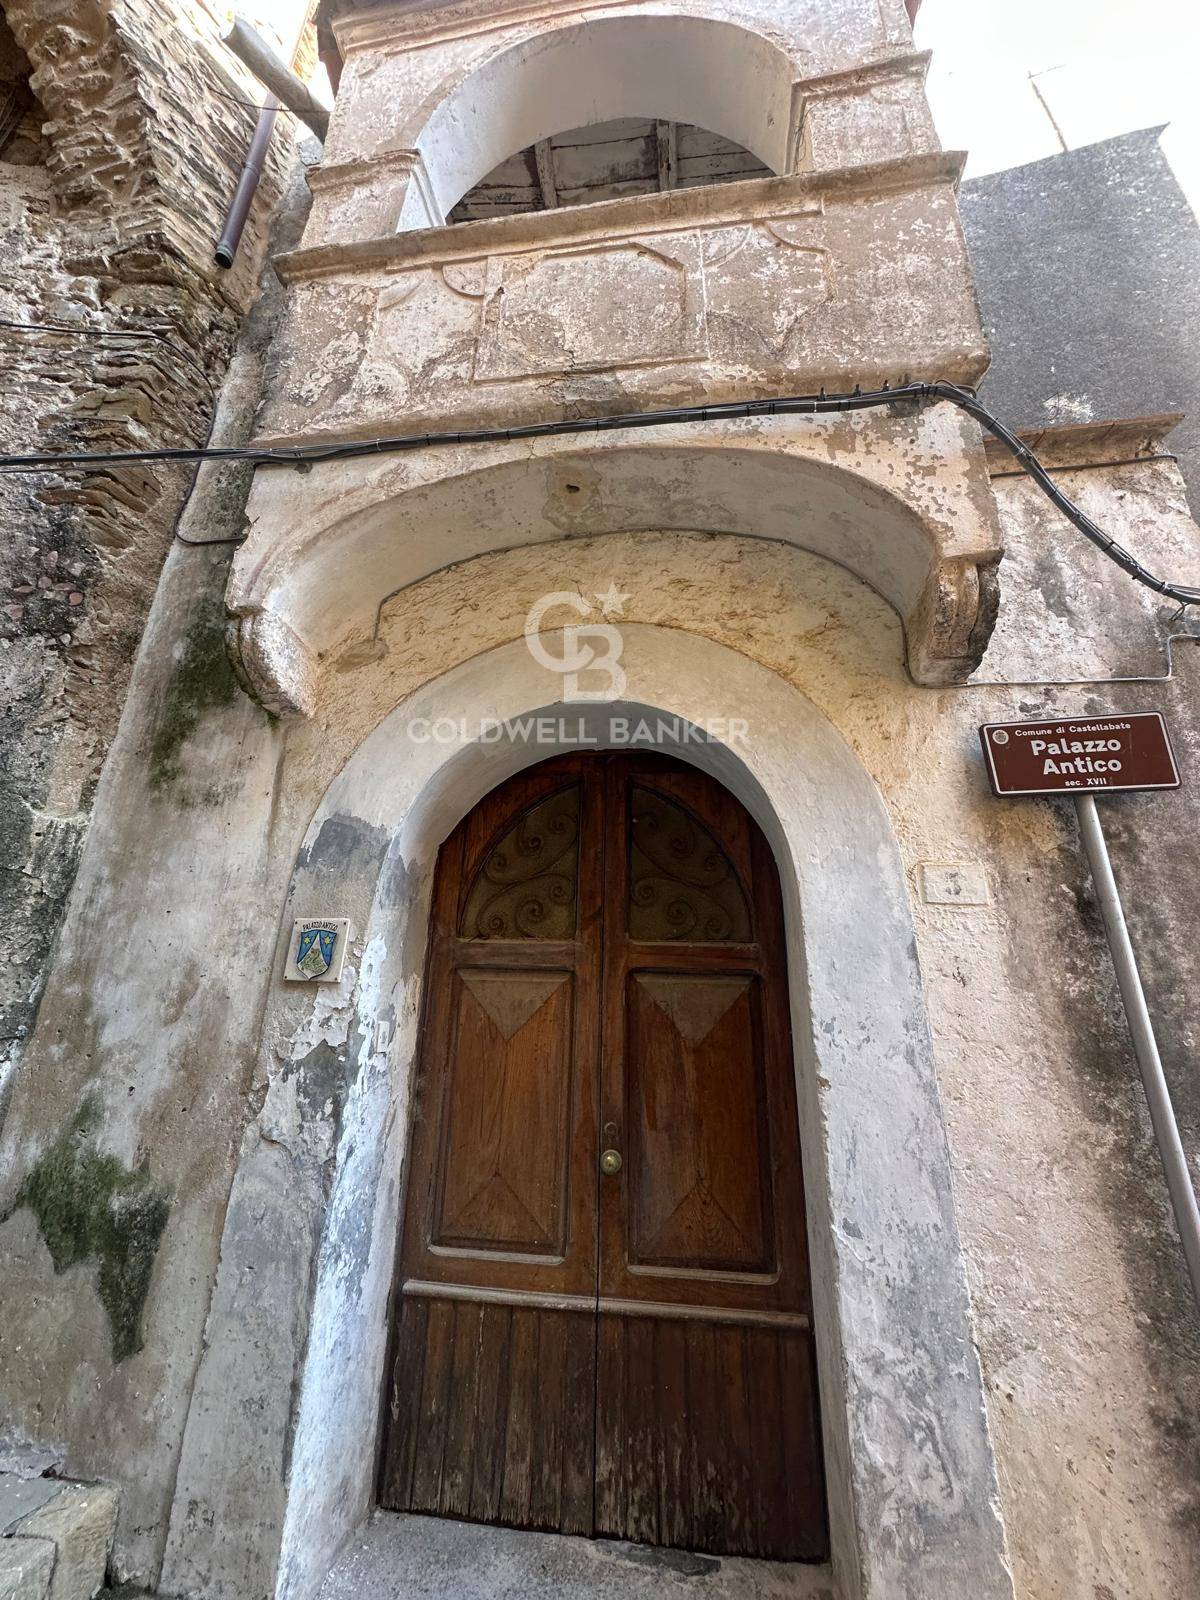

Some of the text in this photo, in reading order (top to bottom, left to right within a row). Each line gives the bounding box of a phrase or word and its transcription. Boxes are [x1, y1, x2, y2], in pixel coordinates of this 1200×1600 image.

[1014, 722, 1131, 737] Comune di Castellabate
[1030, 738, 1122, 756] Palazzo
[1043, 757, 1122, 775] Antico
[1065, 777, 1107, 787] sec. XVII
